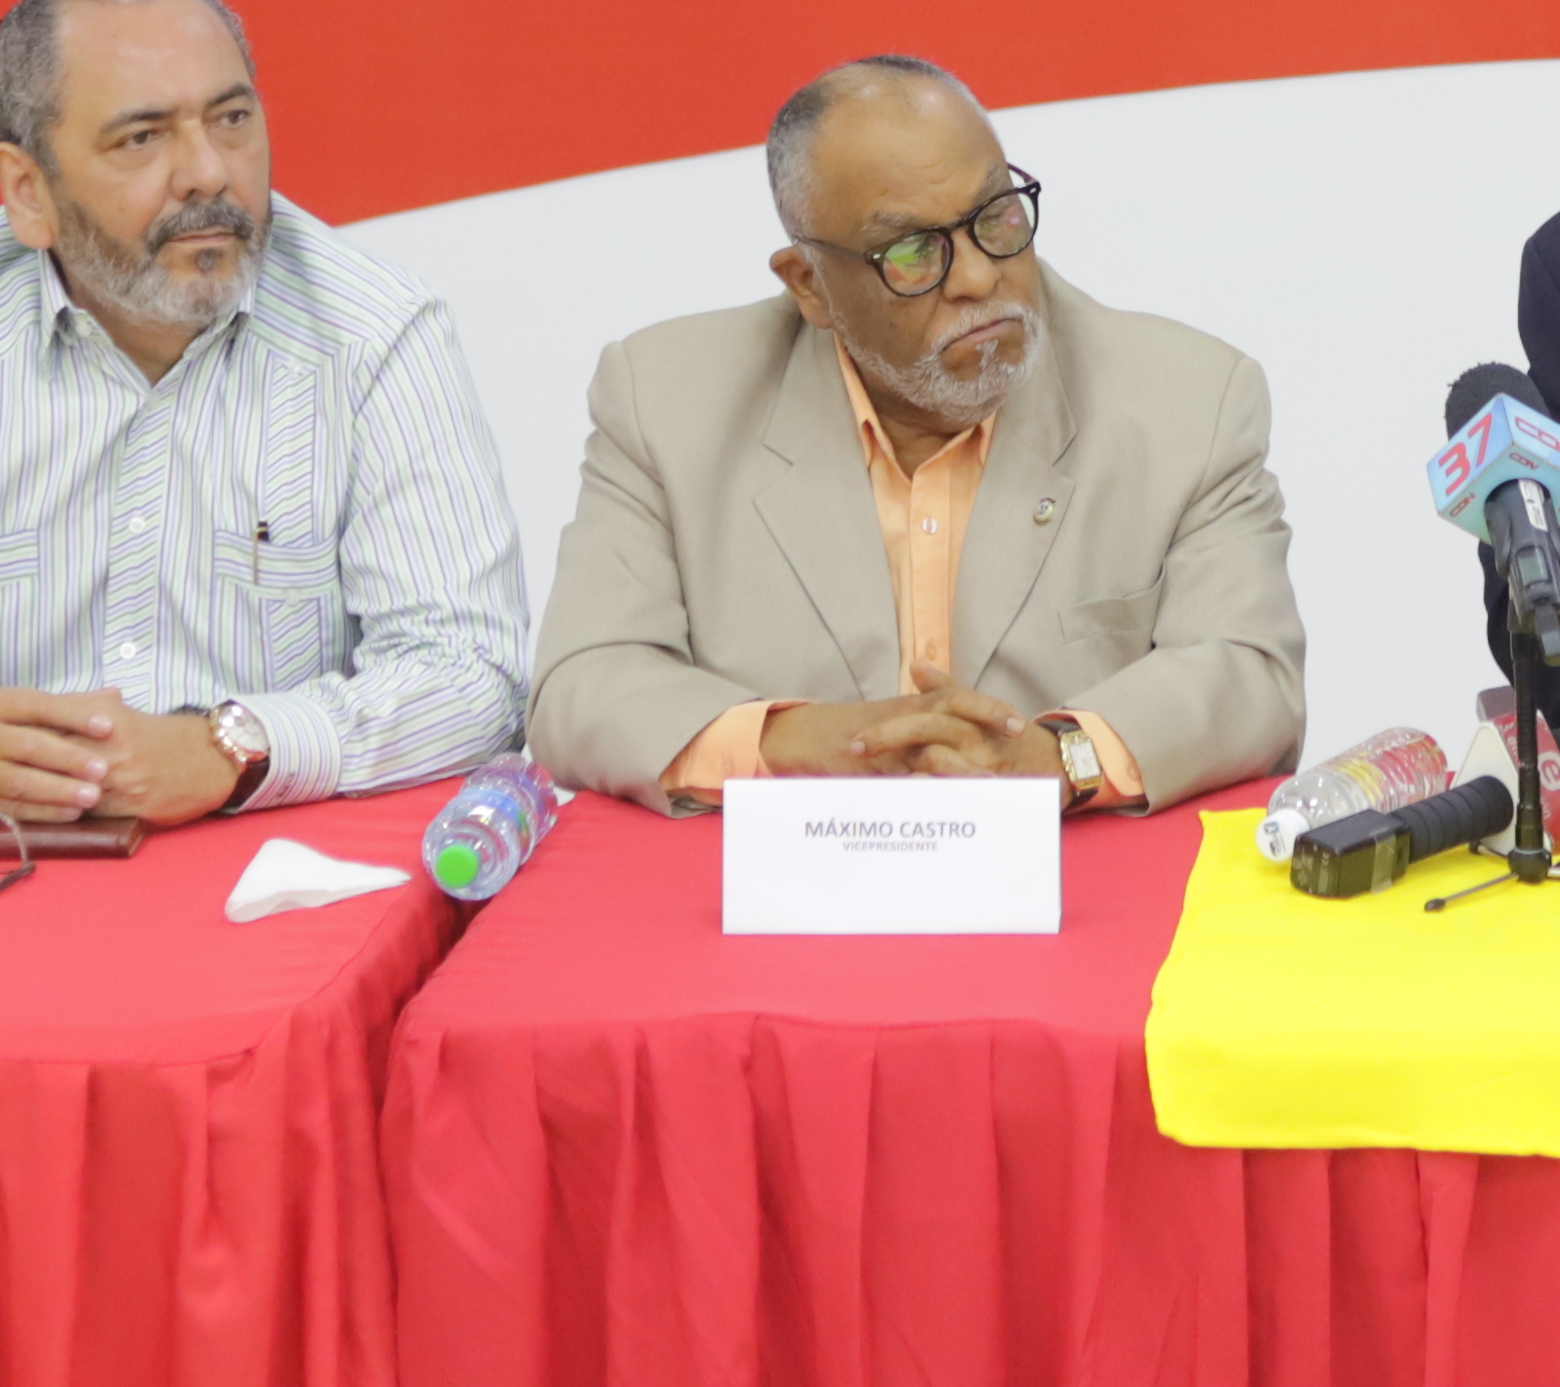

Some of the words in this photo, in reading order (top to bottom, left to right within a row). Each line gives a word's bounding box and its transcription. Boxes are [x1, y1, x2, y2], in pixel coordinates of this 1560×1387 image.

[1438, 412, 1492, 497] 37
[804, 818, 893, 839] MÁXIMO
[899, 822, 976, 839] CASTRO
[843, 841, 938, 852] VICEPRESIDENTE
